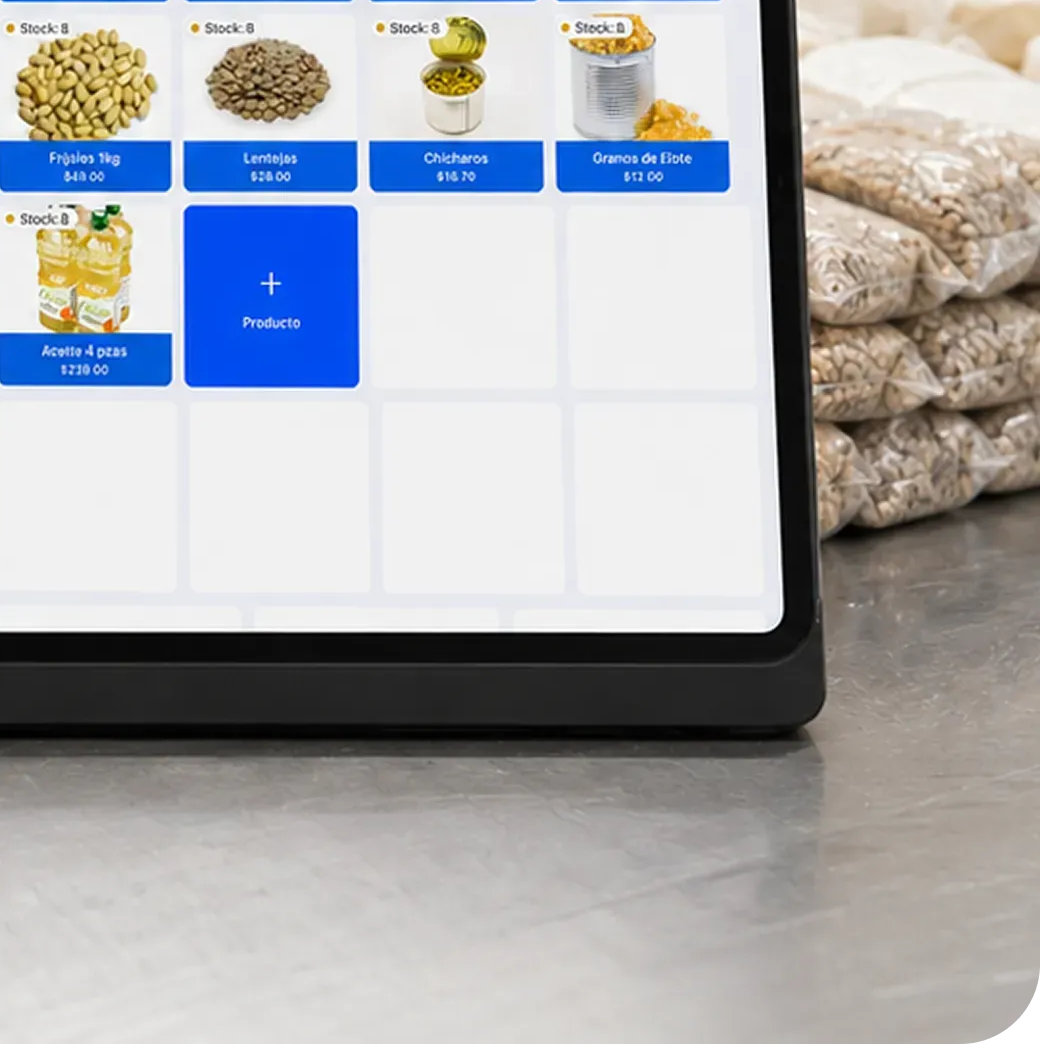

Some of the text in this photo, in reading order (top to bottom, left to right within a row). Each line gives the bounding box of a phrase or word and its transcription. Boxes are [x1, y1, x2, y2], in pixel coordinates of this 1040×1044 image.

[19, 22, 70, 35] Stock: 8
[204, 21, 255, 35] Stock: 8
[389, 21, 441, 35] Stock: 8
[574, 20, 615, 35] Stock:
[640, 151, 658, 165] de
[59, 211, 70, 227] 8
[242, 316, 301, 330] Producto
[84, 344, 95, 357] 4
